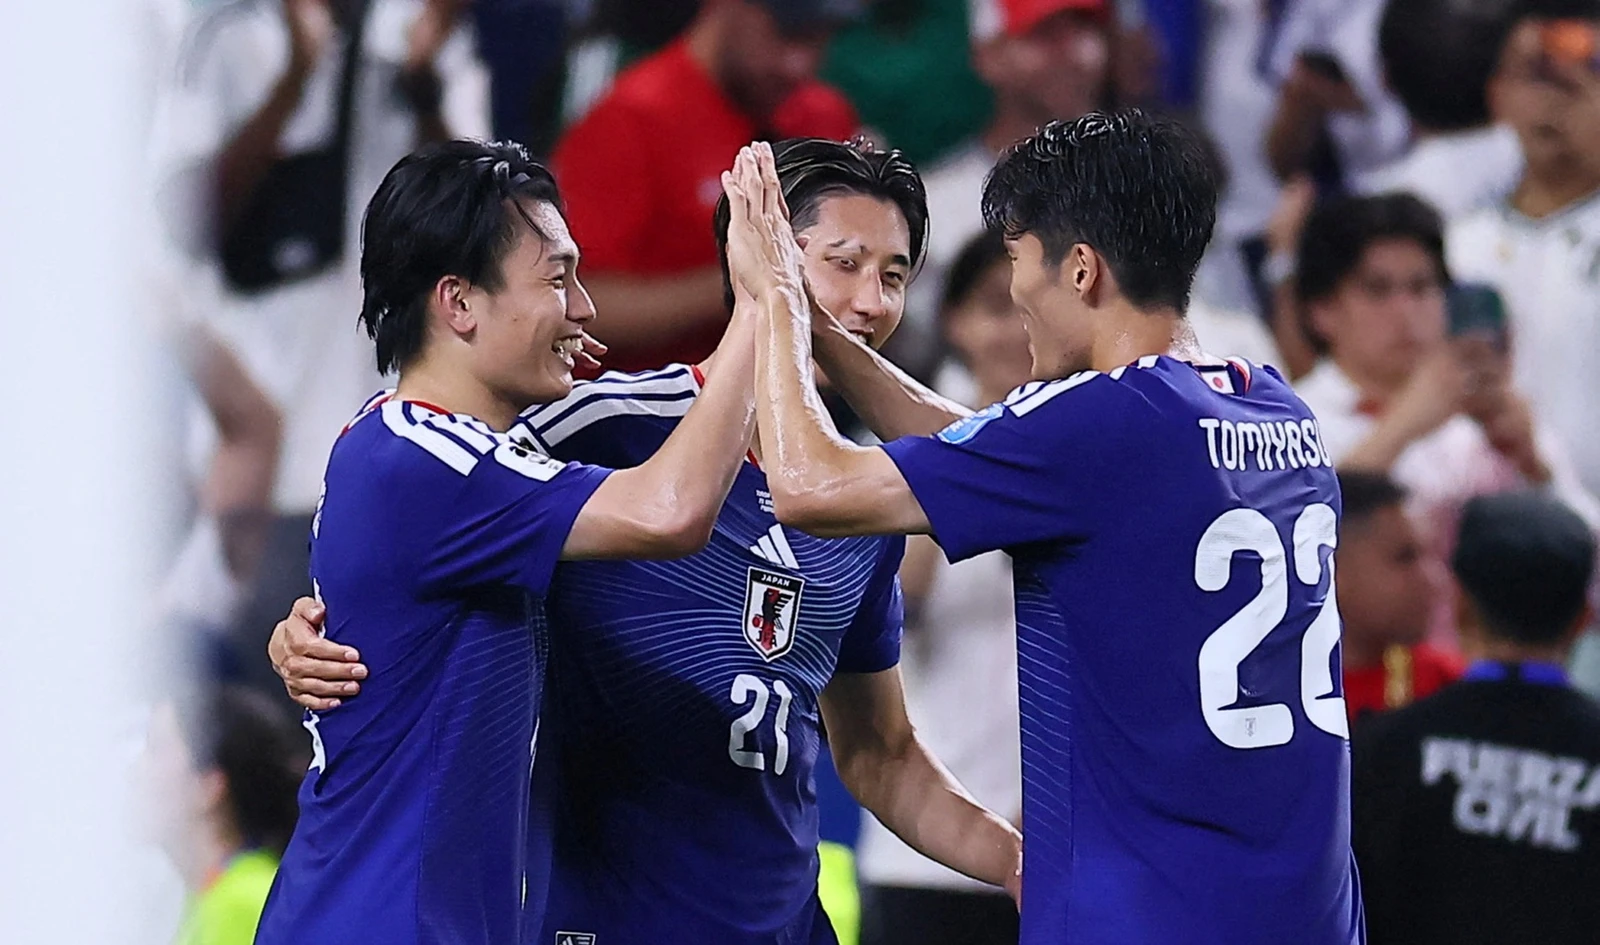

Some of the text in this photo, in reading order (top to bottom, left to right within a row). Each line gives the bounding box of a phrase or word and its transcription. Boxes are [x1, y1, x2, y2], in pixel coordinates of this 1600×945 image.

[761, 574, 790, 587] JAPAN
[1194, 503, 1350, 748] 22
[728, 674, 792, 775] 21
